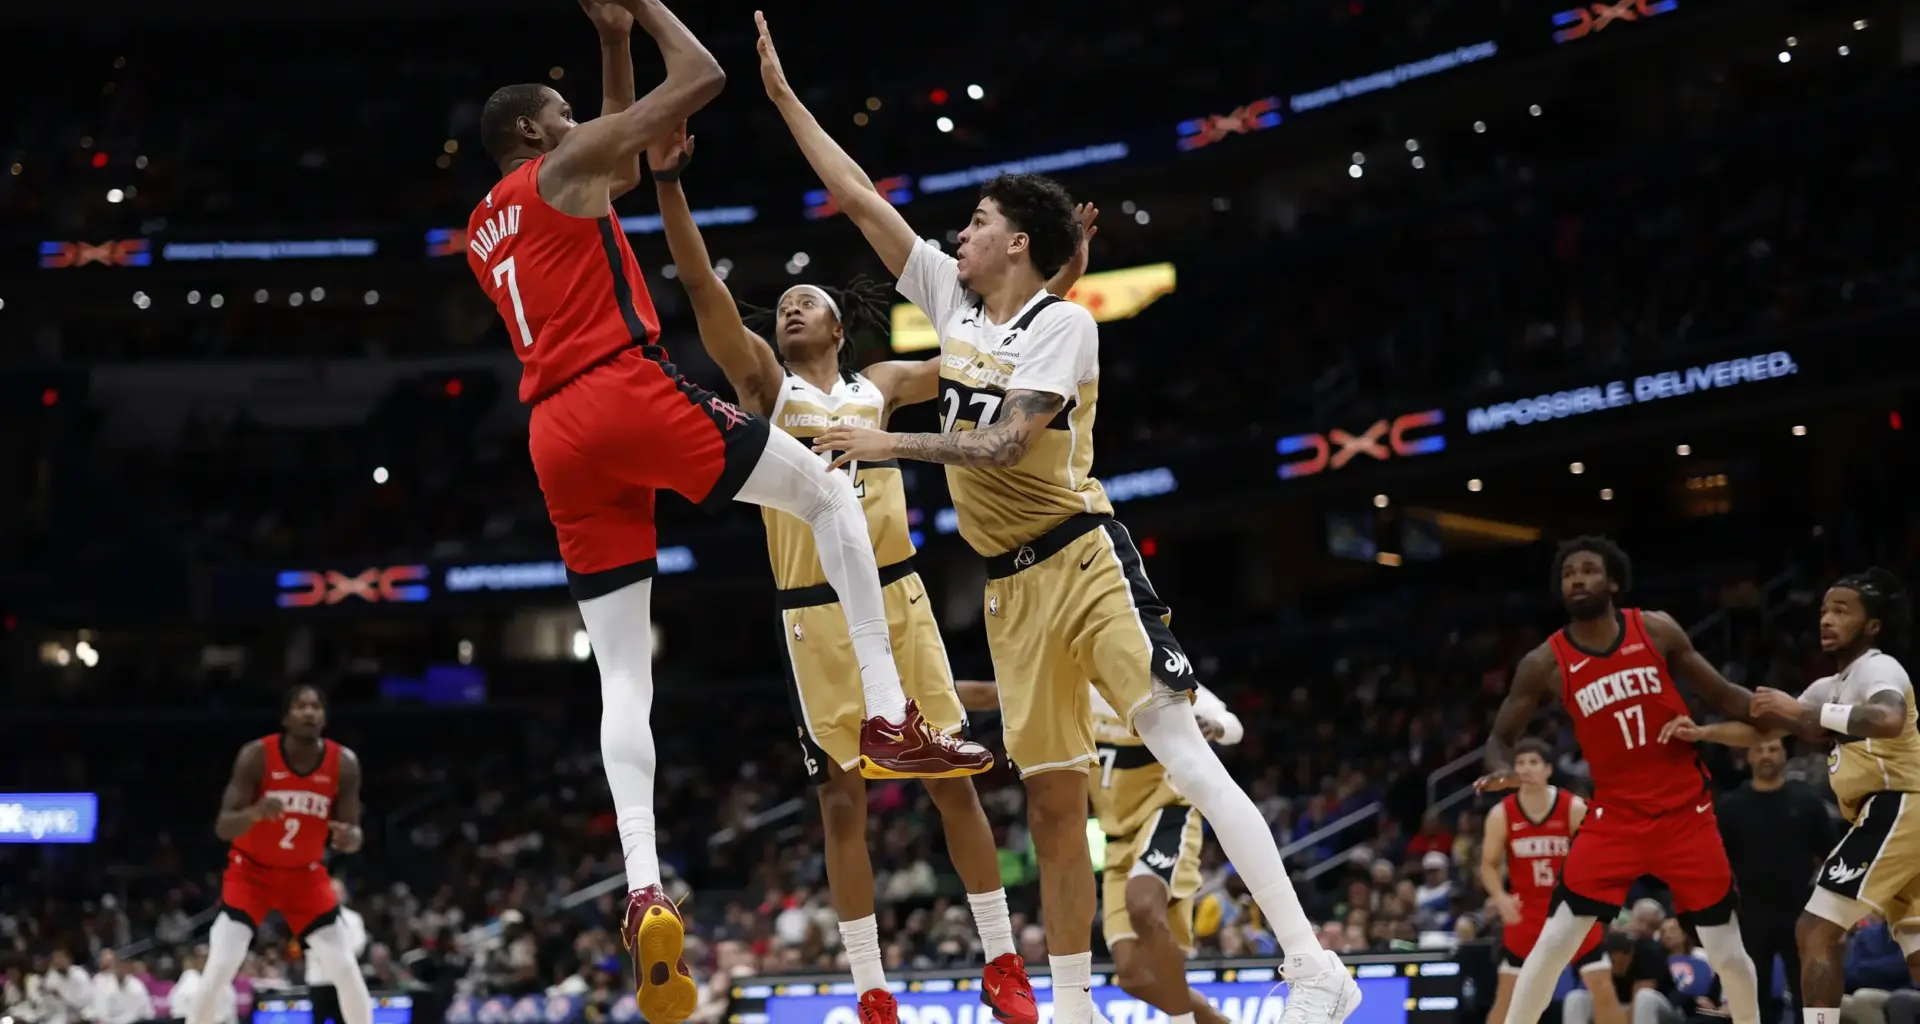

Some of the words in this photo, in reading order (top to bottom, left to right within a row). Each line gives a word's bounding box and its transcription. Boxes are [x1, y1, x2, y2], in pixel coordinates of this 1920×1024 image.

[470, 205, 522, 262] DURANT
[491, 255, 533, 347] 7
[942, 387, 1003, 435] 27
[1466, 380, 1632, 434] IMPOSSIBLE.
[1634, 350, 1799, 403] DELIVERED.
[1574, 665, 1662, 718] ROCKETS
[1613, 704, 1647, 750] 17
[278, 818, 300, 849] 2
[1532, 859, 1555, 887] 15
